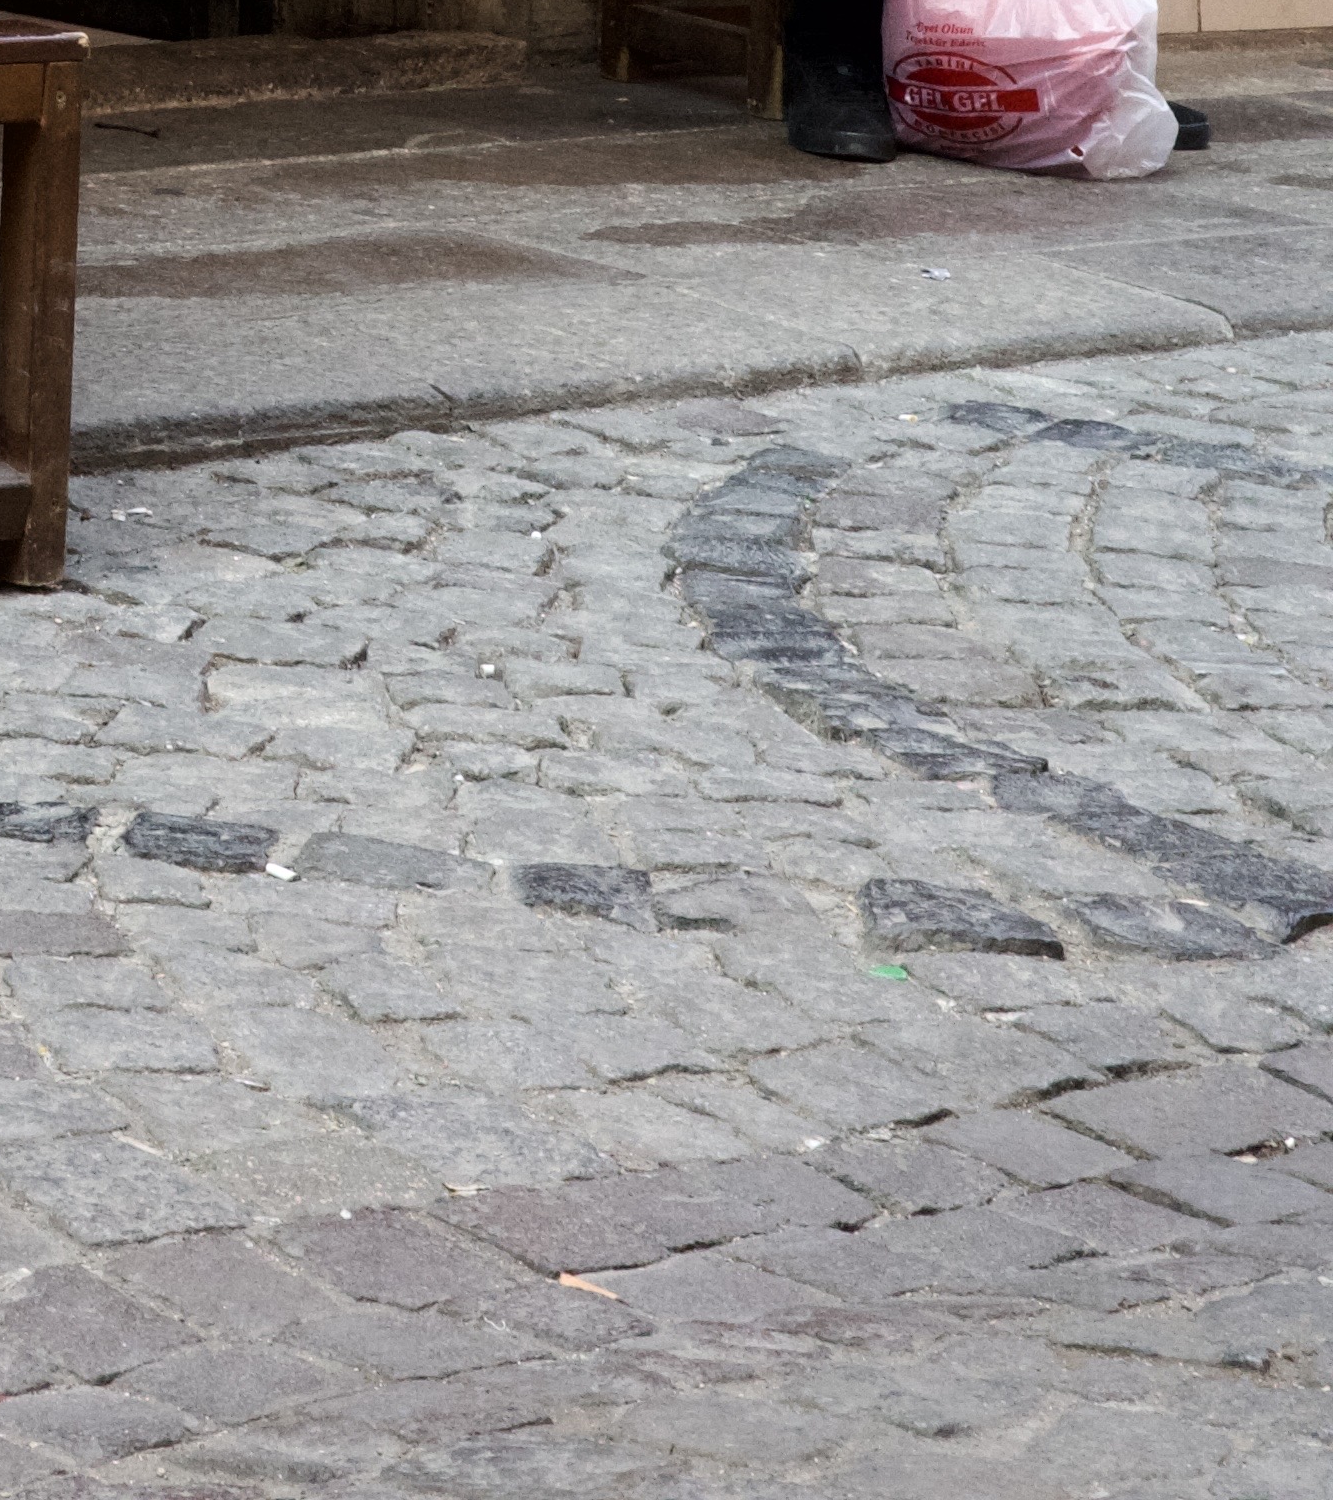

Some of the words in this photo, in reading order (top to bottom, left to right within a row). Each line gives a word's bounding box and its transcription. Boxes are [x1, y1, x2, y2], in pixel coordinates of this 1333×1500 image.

[940, 23, 974, 35] Olsun
[904, 84, 949, 110] GEL
[952, 90, 1005, 113] GEL
